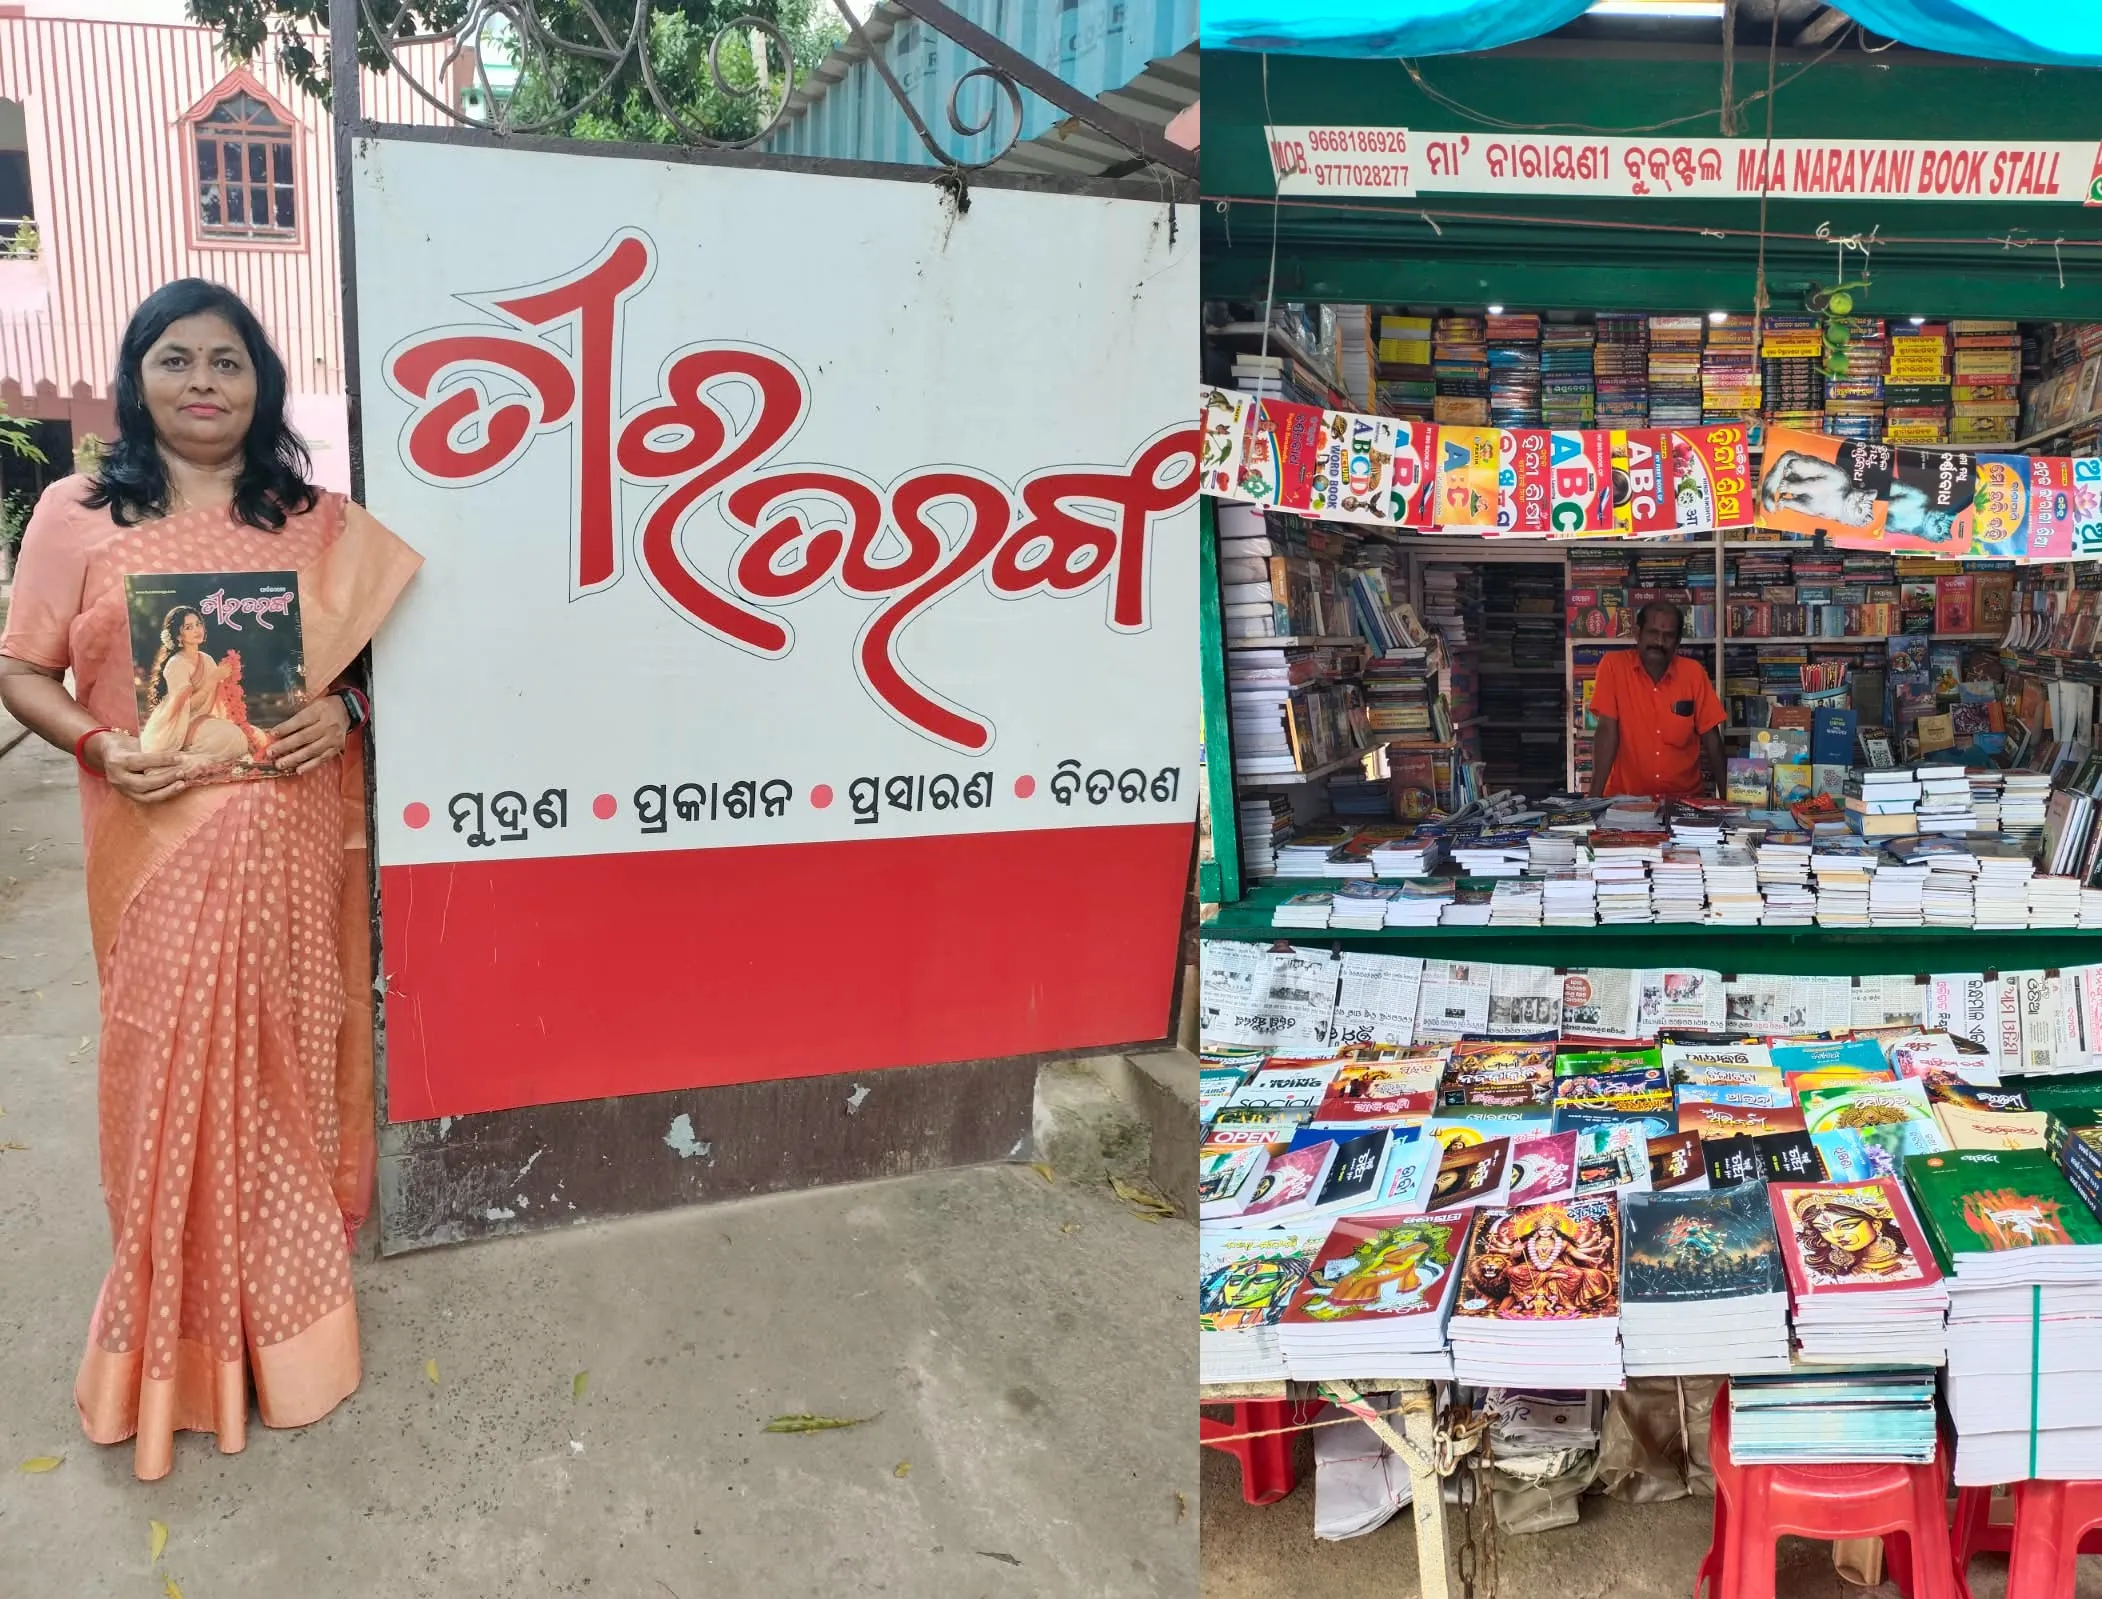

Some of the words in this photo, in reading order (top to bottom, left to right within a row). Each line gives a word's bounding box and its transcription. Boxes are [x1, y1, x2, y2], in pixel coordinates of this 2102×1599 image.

[1308, 129, 1406, 154] 9668186926
[1485, 142, 1610, 180] ନାରାୟଣୀ
[1315, 164, 1409, 188] 9777028277
[1736, 147, 1787, 192] MAA
[1793, 147, 1916, 194] NARAYANI
[1917, 149, 1989, 195] BOOK
[1989, 150, 2061, 196] STALL
[1328, 444, 1341, 478] WORD
[1350, 418, 1375, 497] ABCD
[1326, 479, 1338, 511] BOOK
[1551, 434, 1589, 533] ABC
[1627, 440, 1657, 521] ABC
[1716, 477, 1746, 521] ଶିକ୍ଷା
[447, 787, 569, 847] ମୁଦ୍ରଣ
[632, 776, 794, 834] ପ୍ରକାଶନ
[847, 768, 994, 824] ପ୍ରସାରଣ
[1049, 758, 1181, 806] ବିତରଣ
[1213, 1130, 1279, 1144] OPEN
